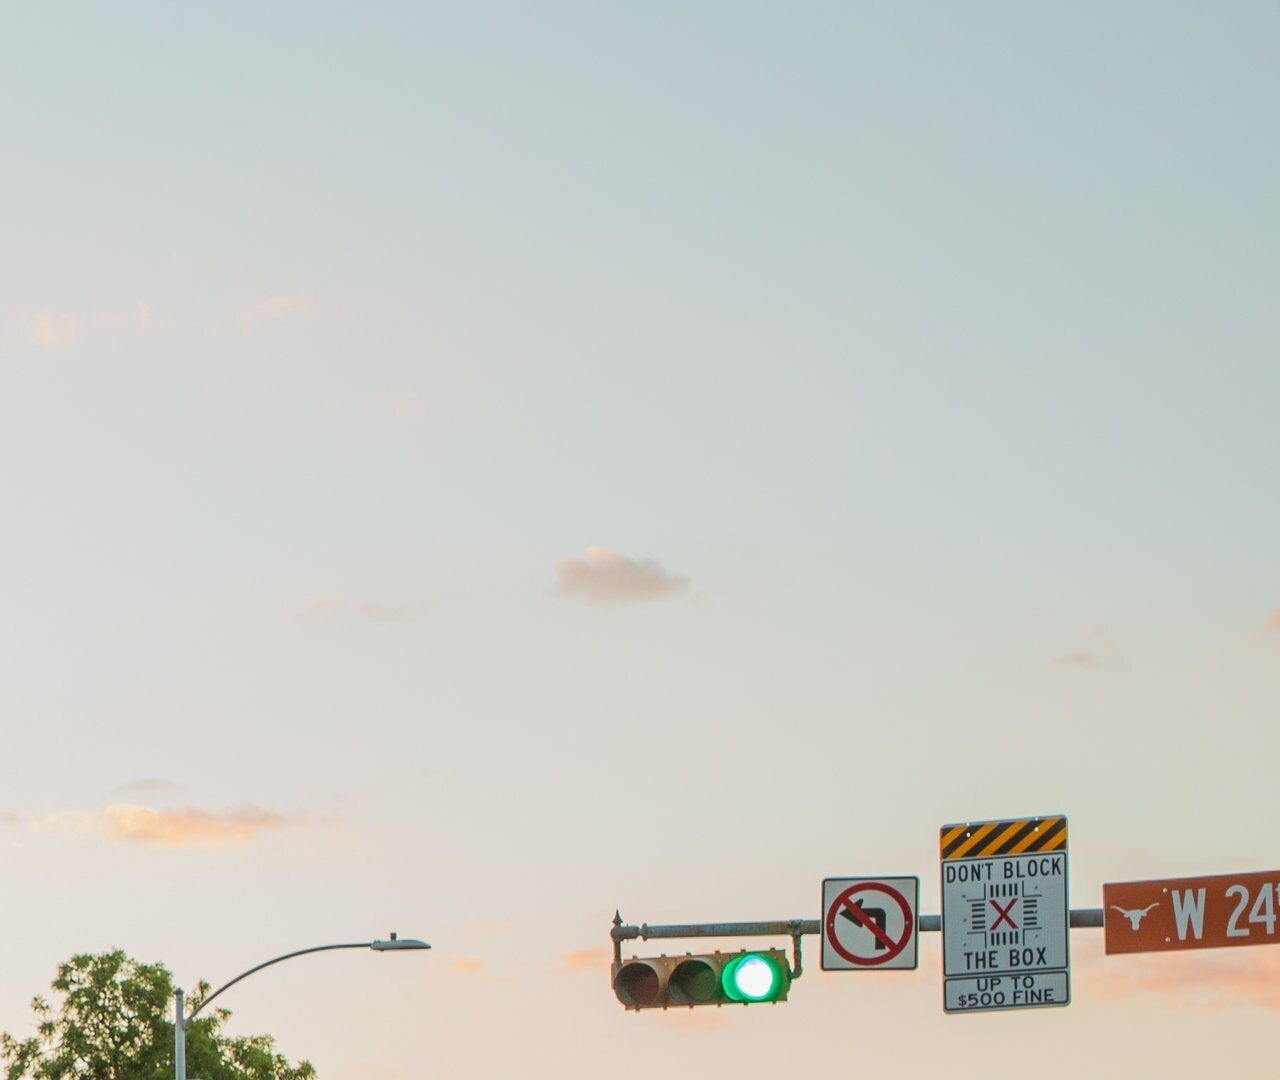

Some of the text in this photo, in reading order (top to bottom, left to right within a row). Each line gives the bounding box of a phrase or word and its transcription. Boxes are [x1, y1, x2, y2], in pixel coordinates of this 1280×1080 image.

[946, 857, 1061, 883] DON'T BLOCK
[1172, 888, 1206, 941] W
[963, 947, 1047, 970] THE BOX
[977, 976, 1034, 992] UP TO
[958, 989, 1054, 1008] $500 FINE
